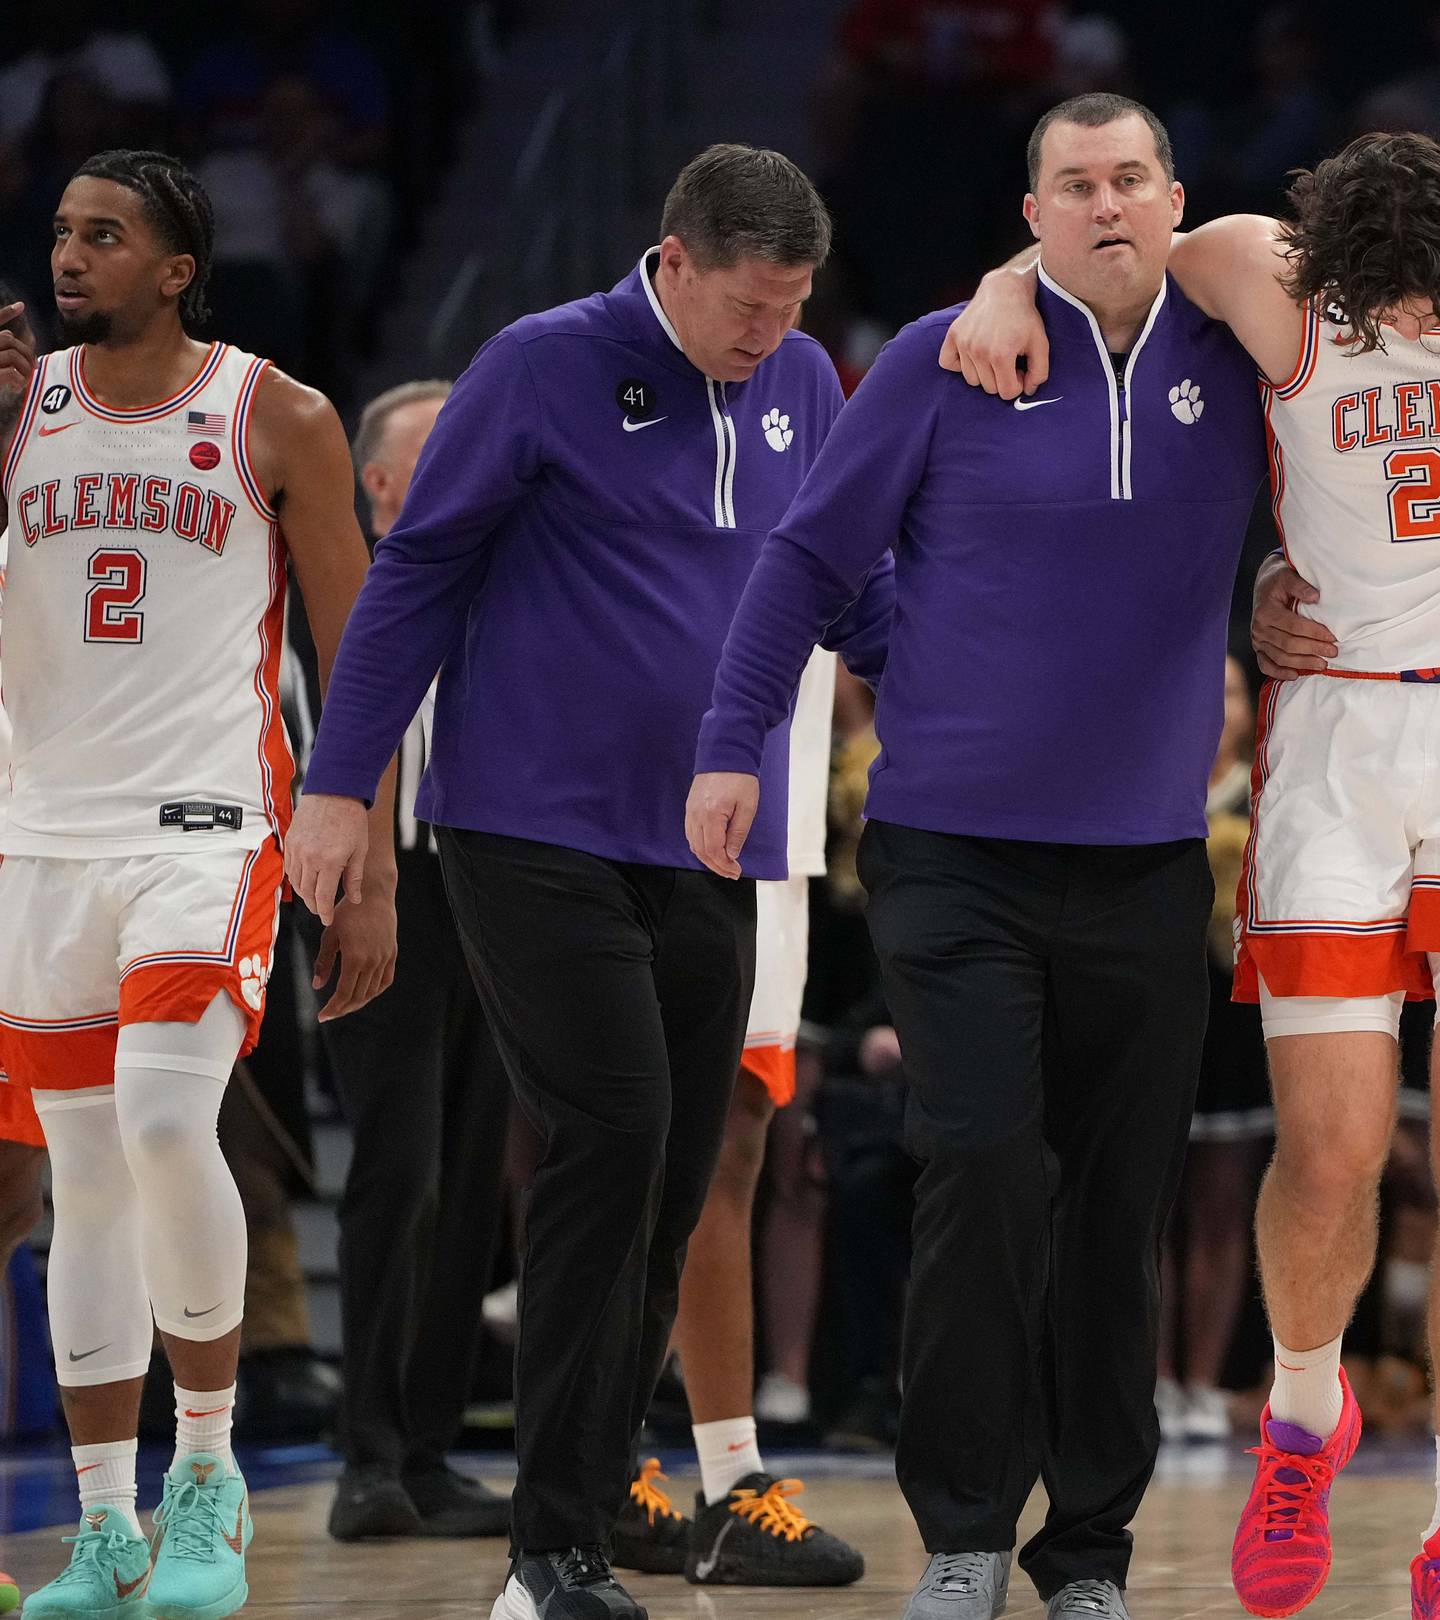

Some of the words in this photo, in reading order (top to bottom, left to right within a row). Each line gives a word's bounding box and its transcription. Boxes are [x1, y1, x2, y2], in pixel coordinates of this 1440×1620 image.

[43, 388, 67, 410] 41
[623, 386, 644, 407] 41
[17, 472, 237, 556] CLEMSON
[84, 548, 147, 643] 2
[219, 810, 232, 821] 44
